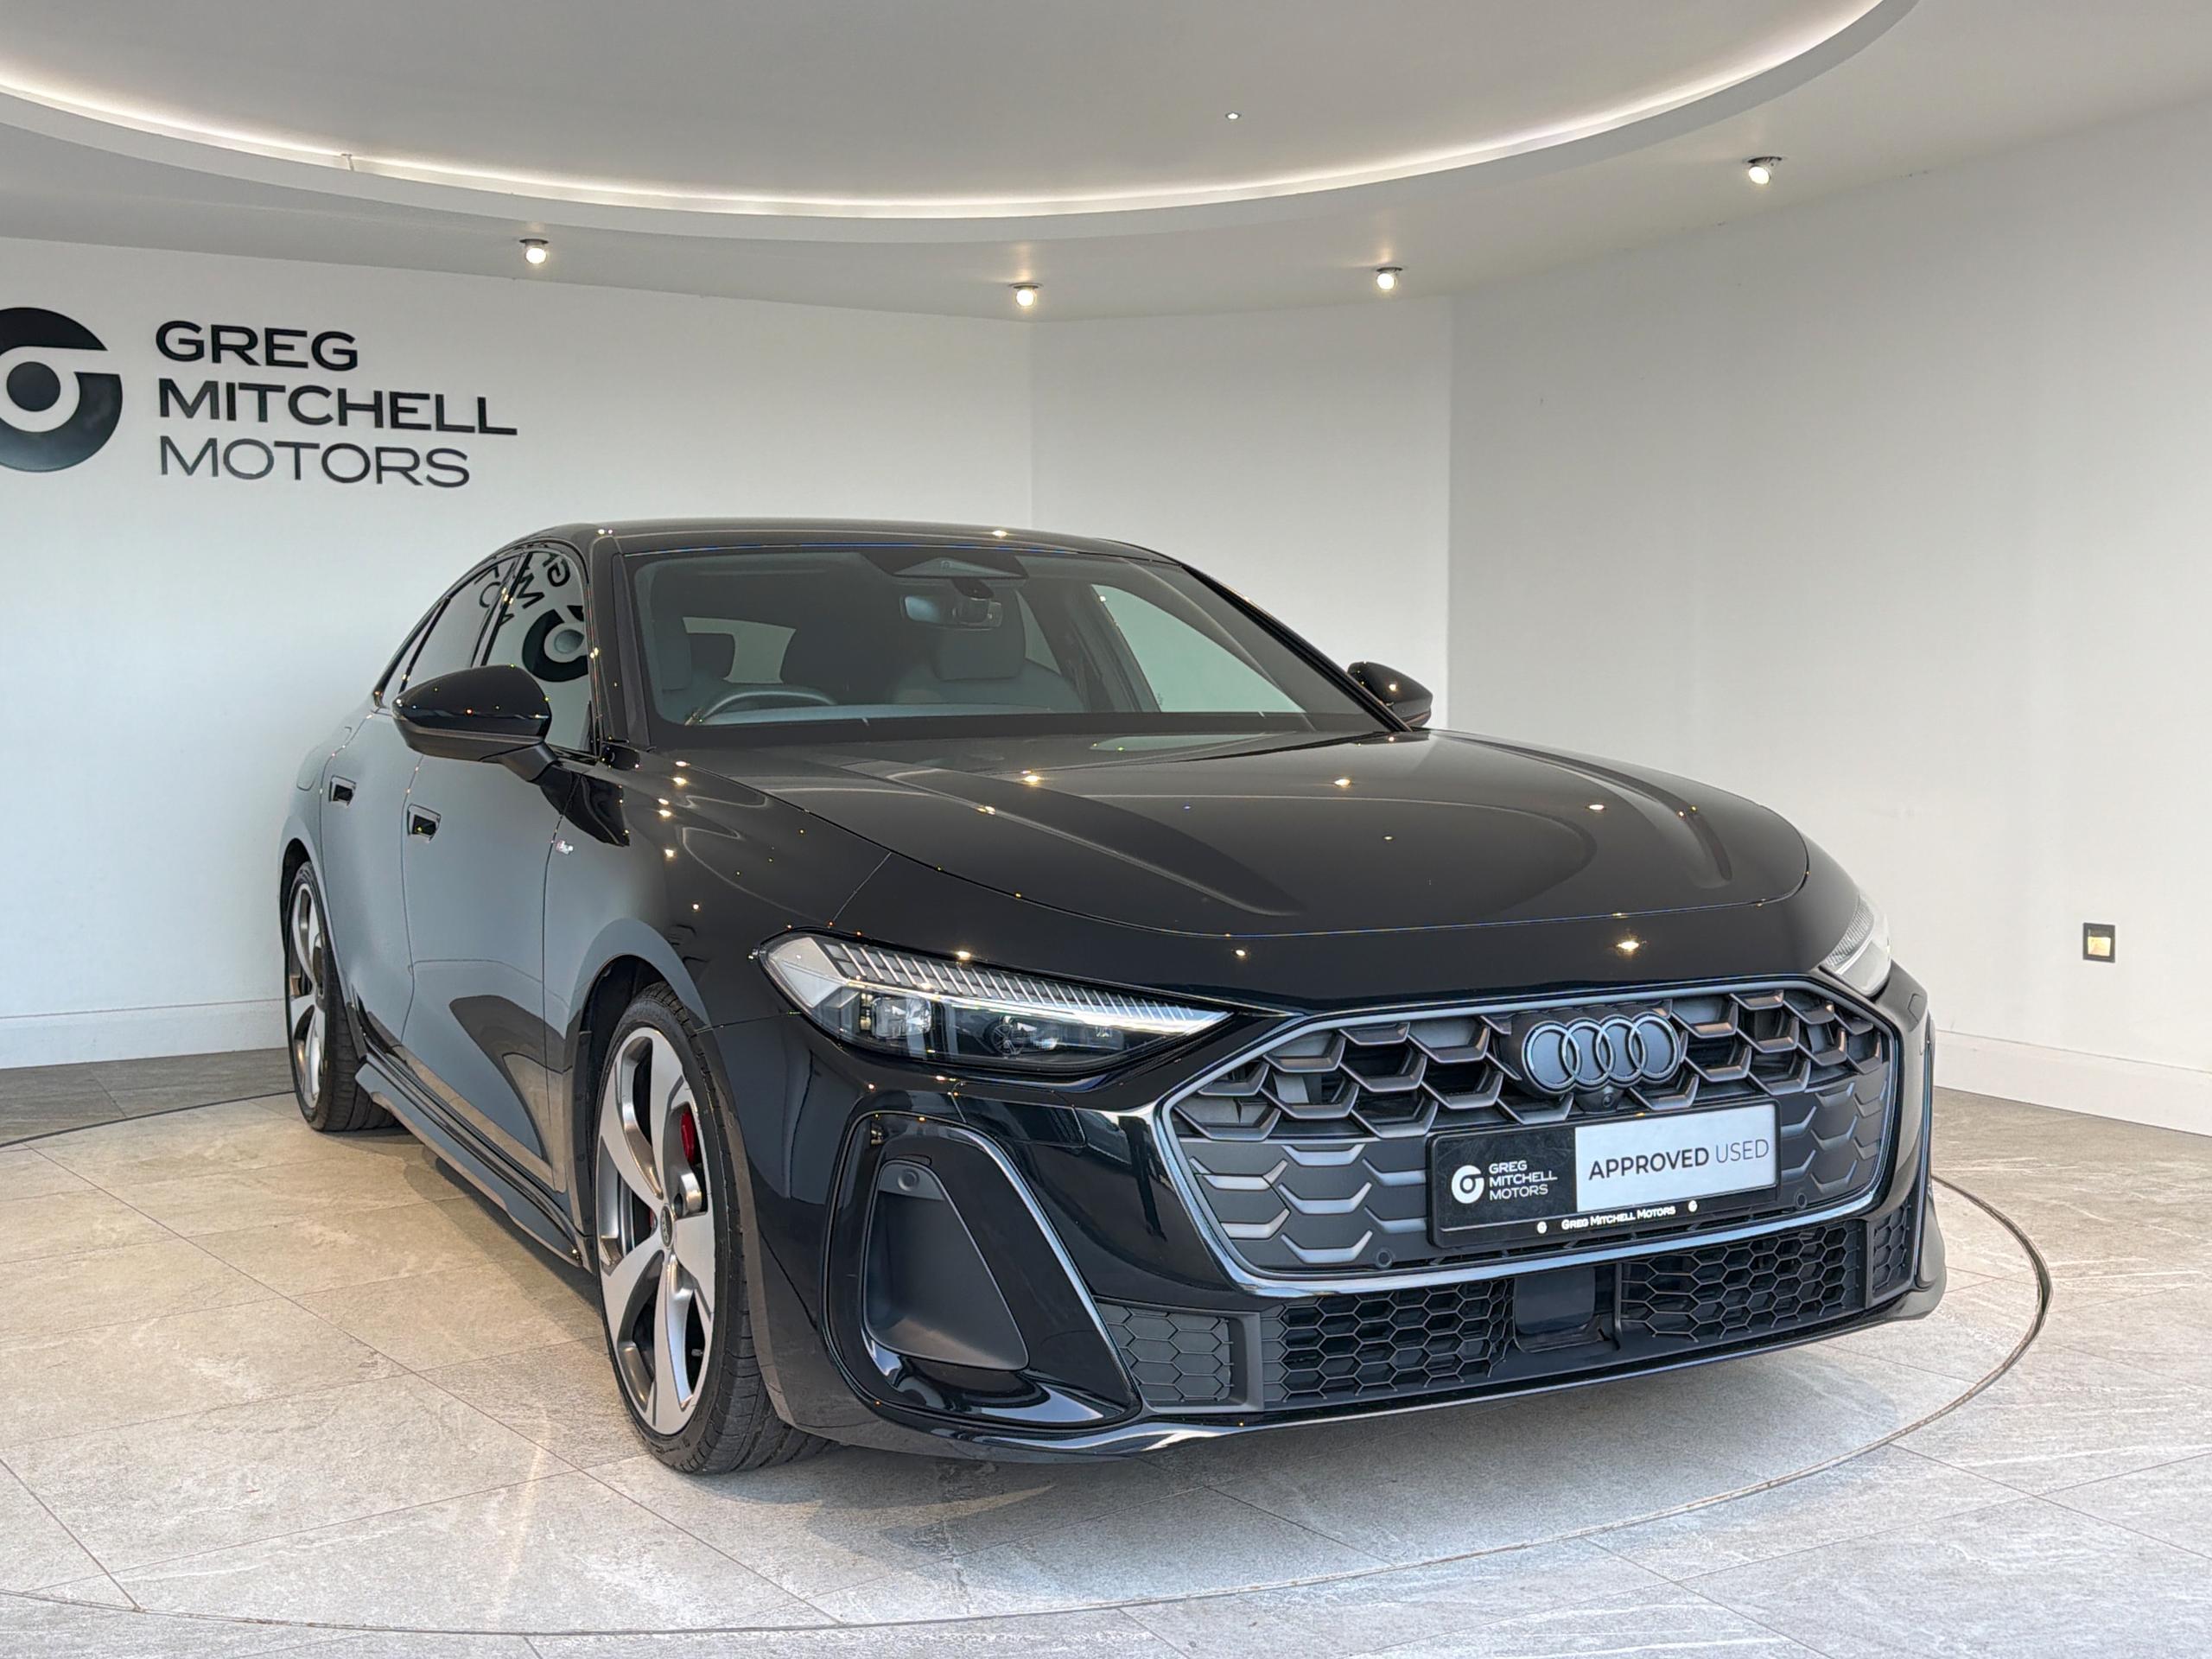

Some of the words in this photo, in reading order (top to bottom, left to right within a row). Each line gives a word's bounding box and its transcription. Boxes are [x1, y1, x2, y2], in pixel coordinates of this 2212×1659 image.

[156, 320, 359, 372] GREG
[158, 378, 518, 435] MITCHELL
[160, 435, 470, 488] MOTORS
[1489, 1160, 1528, 1174] GREG
[1489, 1170, 1558, 1187] MITCHELL
[1588, 1147, 1710, 1180] APPROVED
[1715, 1139, 1770, 1163] USED
[1490, 1184, 1548, 1201] MOTORS
